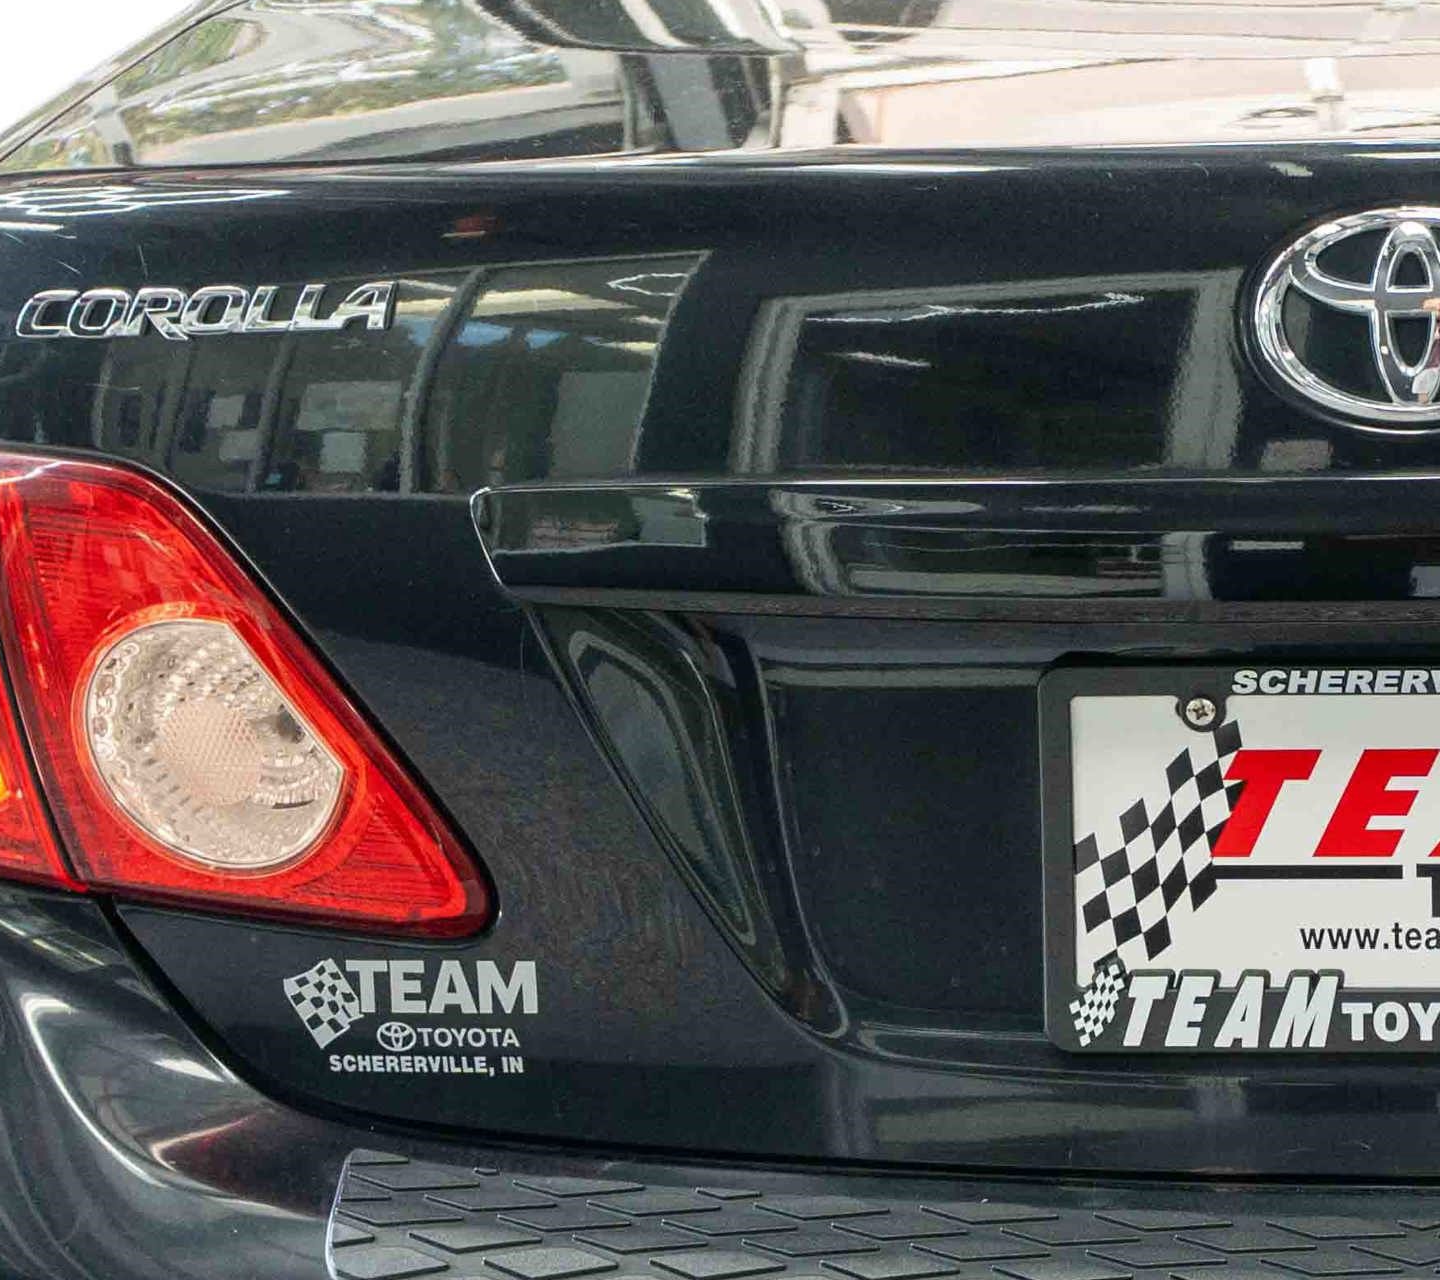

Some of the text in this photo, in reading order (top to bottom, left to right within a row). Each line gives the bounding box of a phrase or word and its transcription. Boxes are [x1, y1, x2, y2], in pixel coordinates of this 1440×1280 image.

[17, 281, 399, 340] COROLLA
[346, 960, 539, 1014] TEAM
[418, 1028, 521, 1047] TOYOTA
[329, 1056, 524, 1077] SCHERERVILLE, IN
